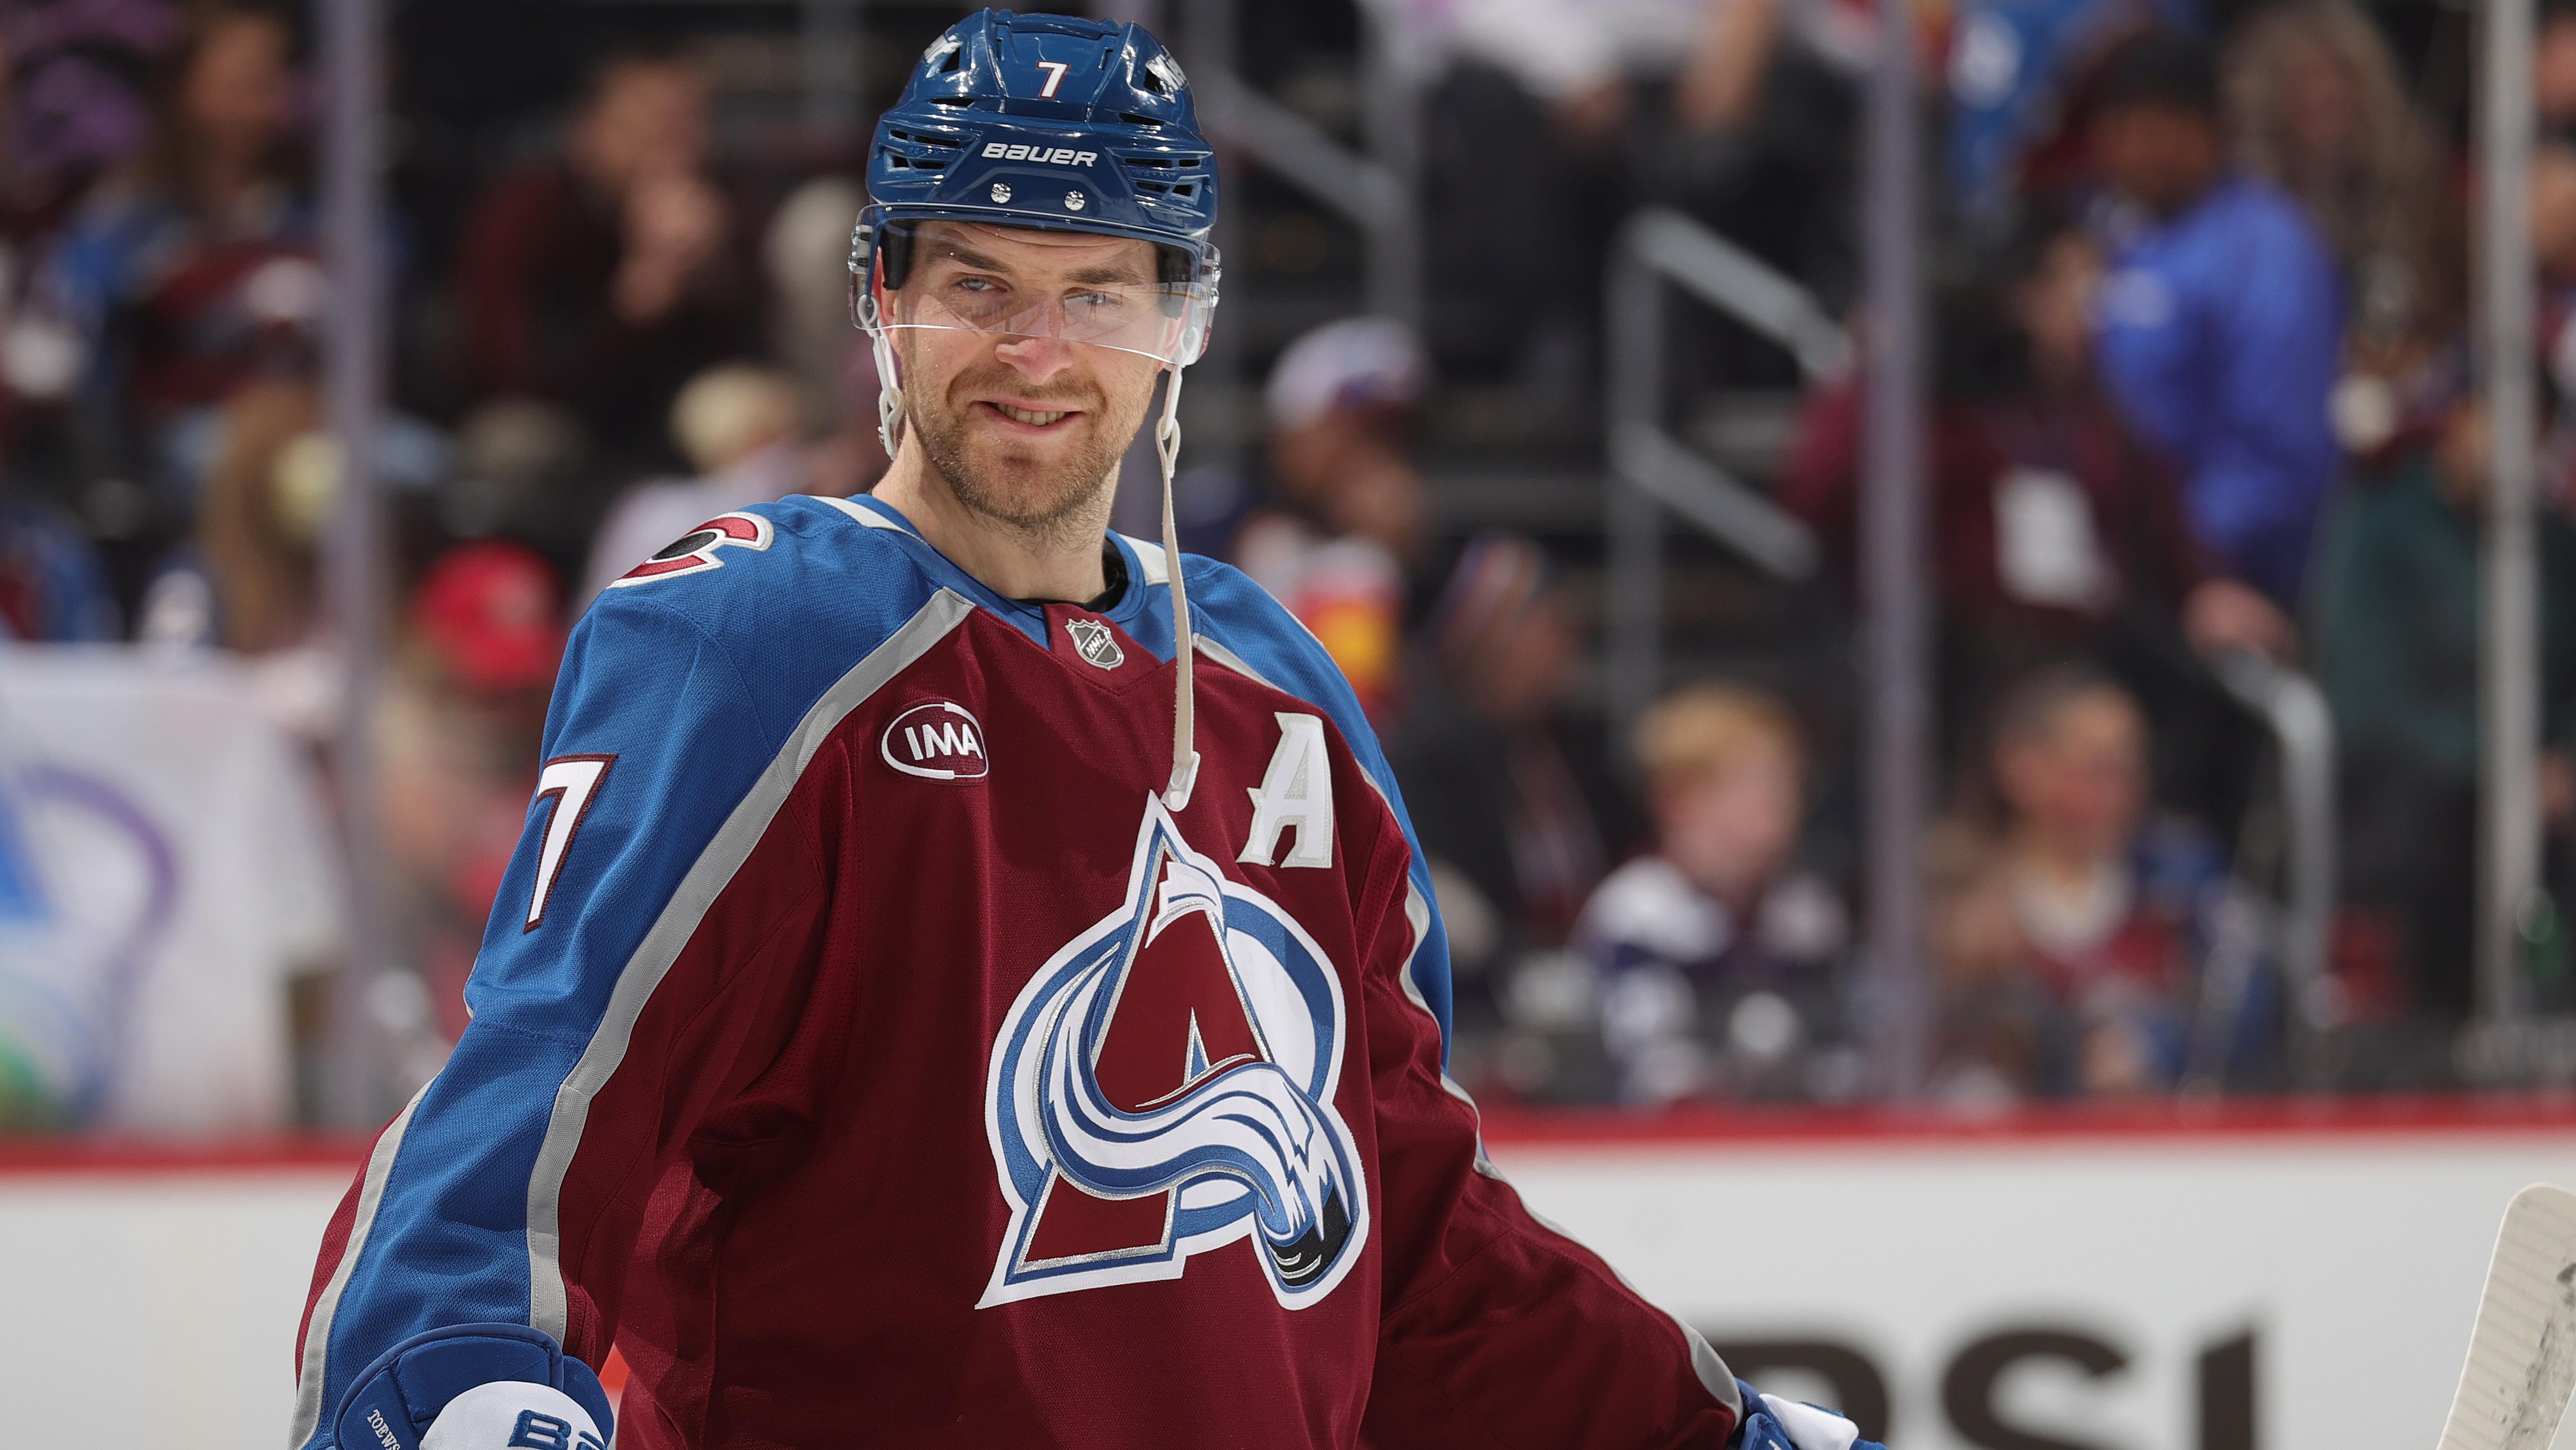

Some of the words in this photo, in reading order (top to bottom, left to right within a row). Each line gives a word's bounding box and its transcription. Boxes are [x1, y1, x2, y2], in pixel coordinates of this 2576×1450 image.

[1036, 60, 1071, 100] 7
[982, 142, 1098, 167] BAUER
[1085, 633, 1106, 658] NHL
[904, 722, 983, 761] IMA
[1235, 711, 1334, 869] A
[523, 752, 618, 935] 7
